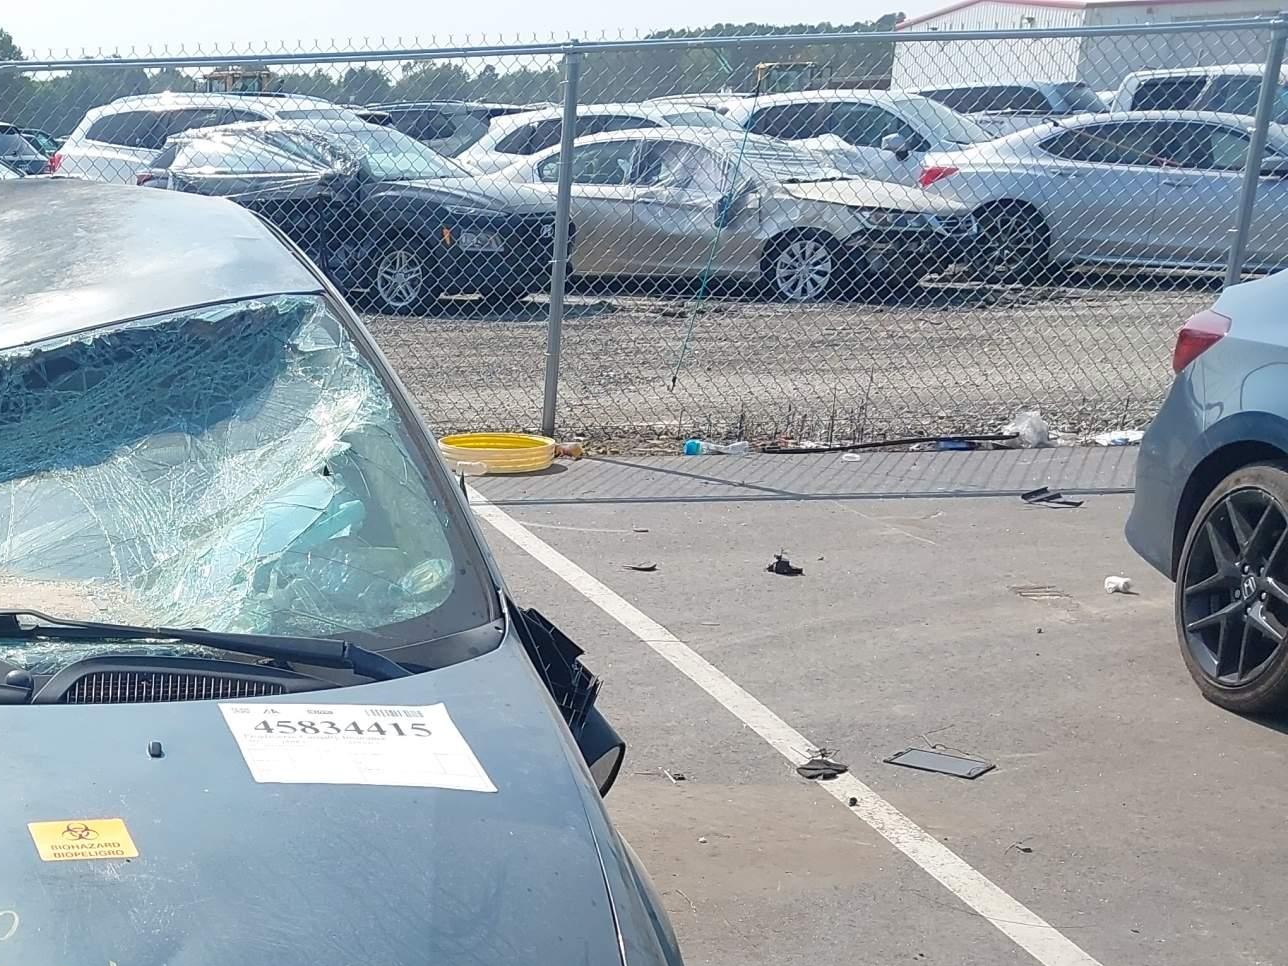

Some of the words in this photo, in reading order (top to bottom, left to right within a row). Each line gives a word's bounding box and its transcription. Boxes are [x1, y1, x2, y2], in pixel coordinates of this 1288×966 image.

[253, 719, 433, 738] 45834415
[50, 841, 121, 851] BIOHAZARD
[53, 849, 125, 859] BIOPELIGRO
